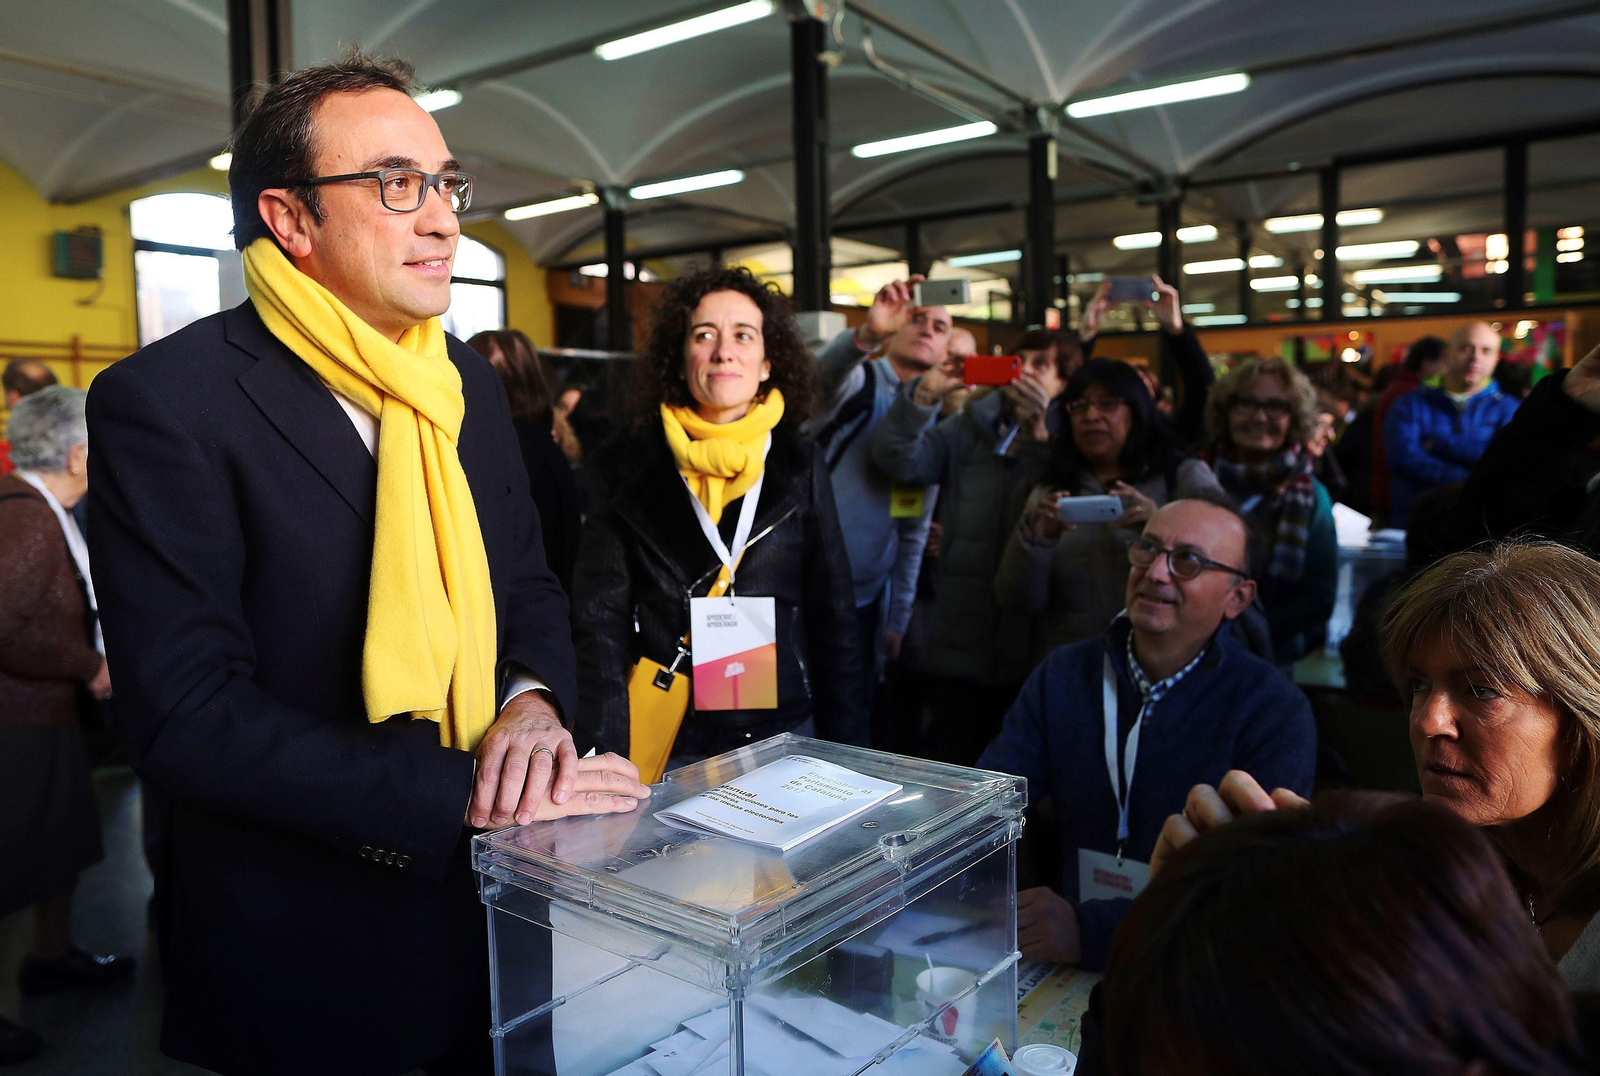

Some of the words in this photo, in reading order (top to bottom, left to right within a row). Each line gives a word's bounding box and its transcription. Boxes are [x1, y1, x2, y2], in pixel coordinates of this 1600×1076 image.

[780, 783, 806, 794] 2017
[798, 775, 854, 796] Parlamento
[807, 771, 859, 791] Elecciones
[720, 799, 744, 811] mesas
[744, 808, 785, 825] electorales
[721, 789, 769, 808] instrucciones
[768, 806, 786, 815] para
